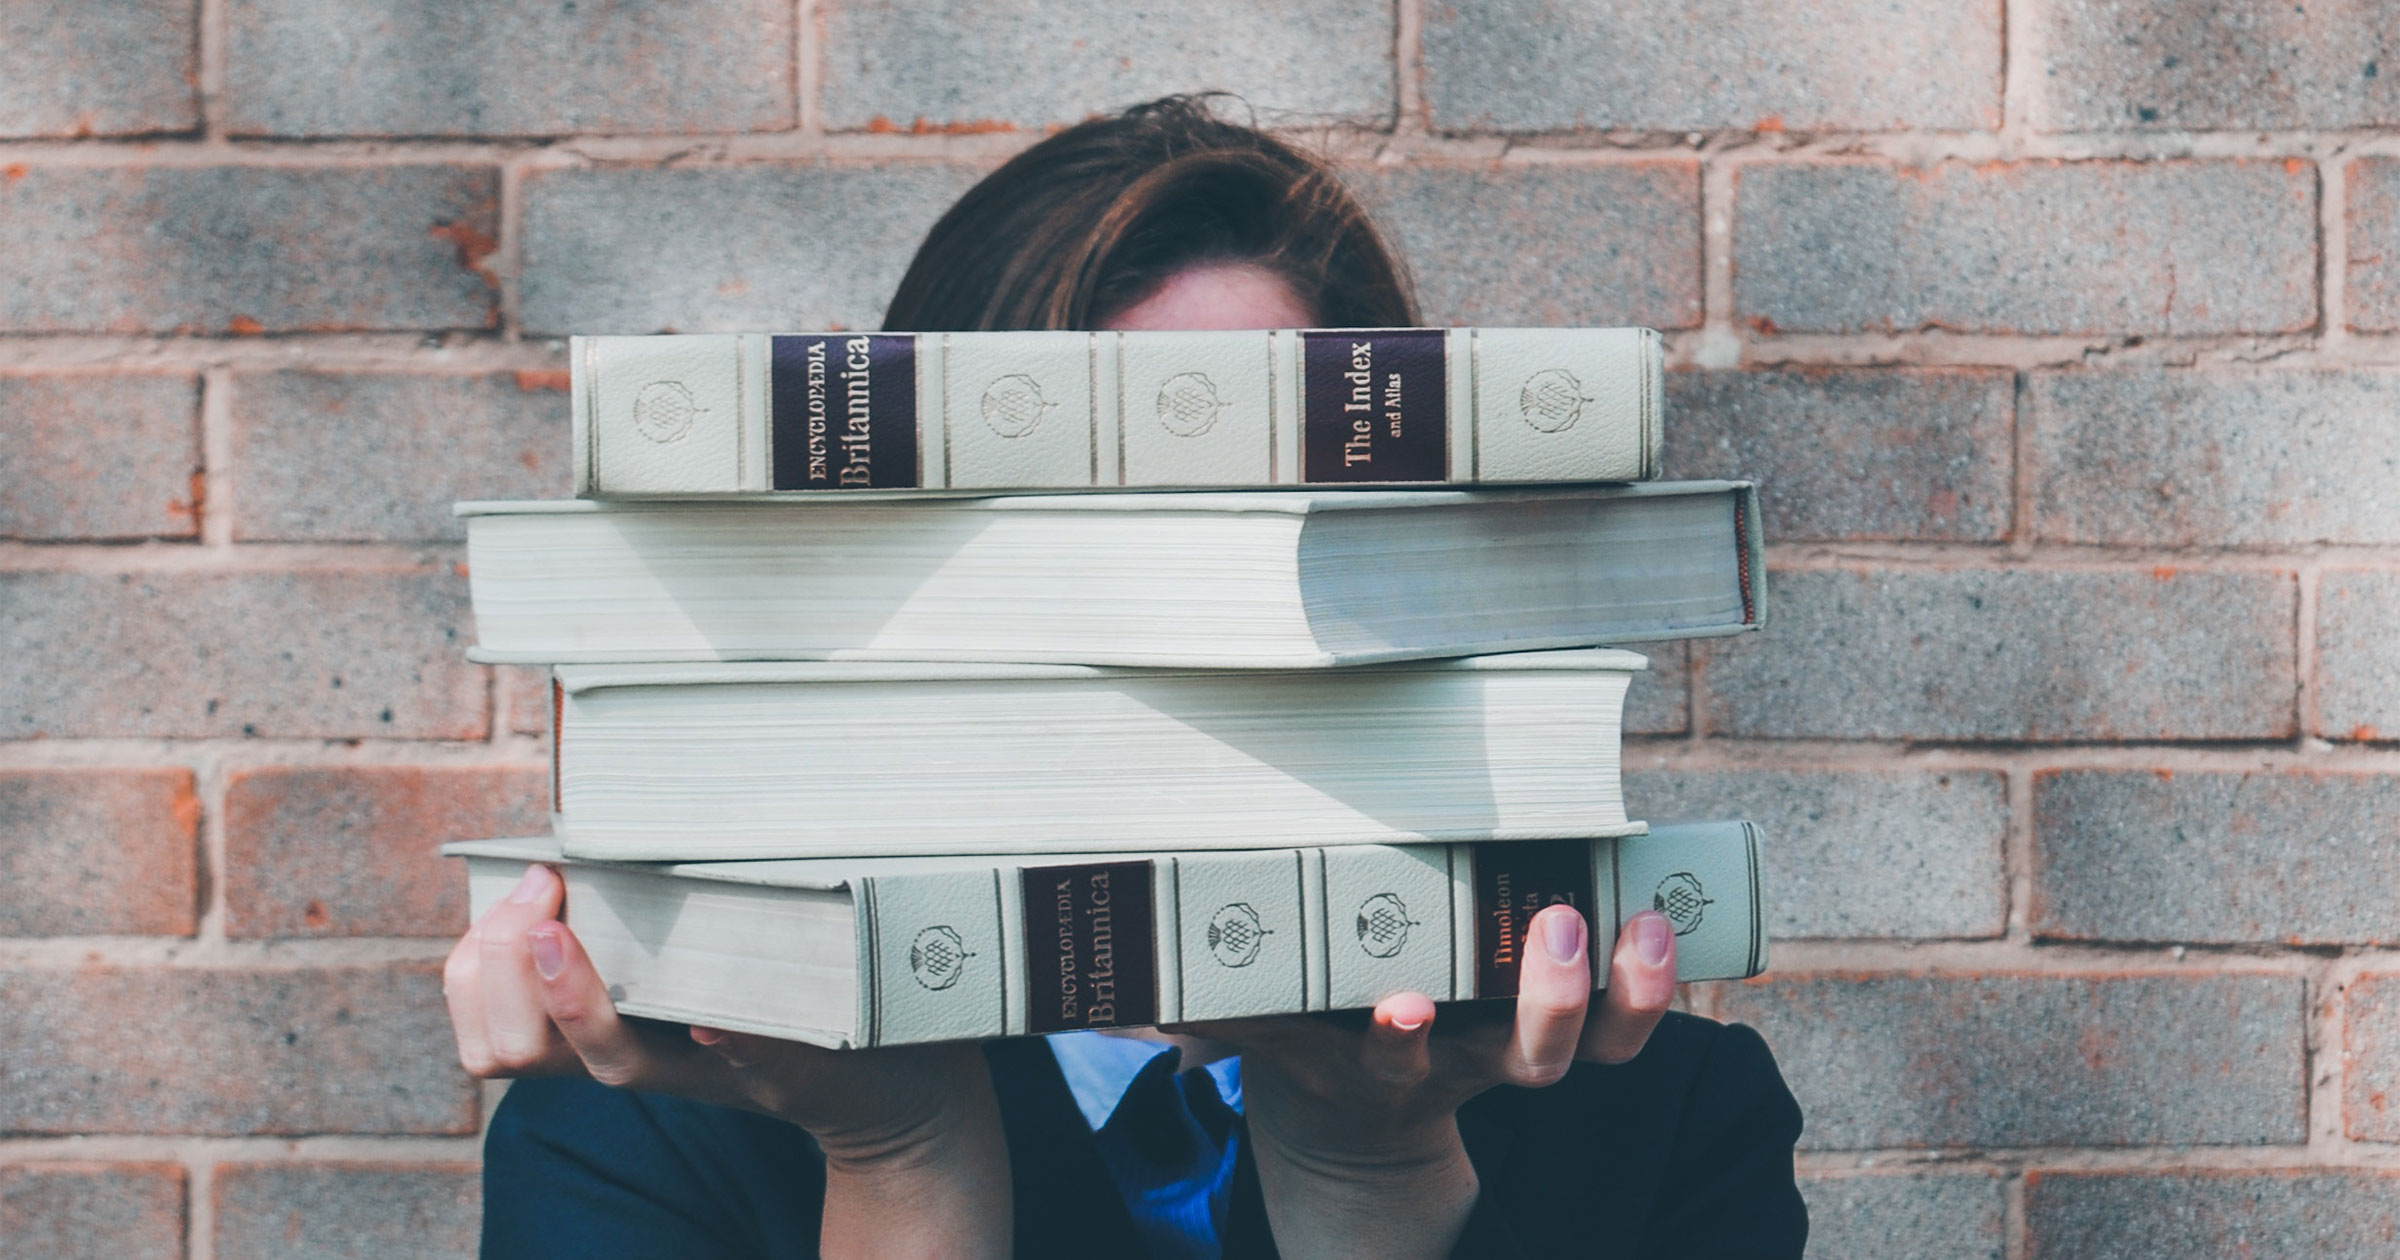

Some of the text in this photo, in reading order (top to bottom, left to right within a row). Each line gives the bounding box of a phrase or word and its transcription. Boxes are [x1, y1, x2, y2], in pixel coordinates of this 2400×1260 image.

[807, 340, 827, 481] ENCYCLOPÆDIA
[839, 335, 871, 487] Britannica
[1344, 341, 1372, 468] The Index
[1384, 372, 1402, 439] and Atlas
[1085, 870, 1116, 1024] Britannica
[1493, 873, 1513, 969] Timoleon
